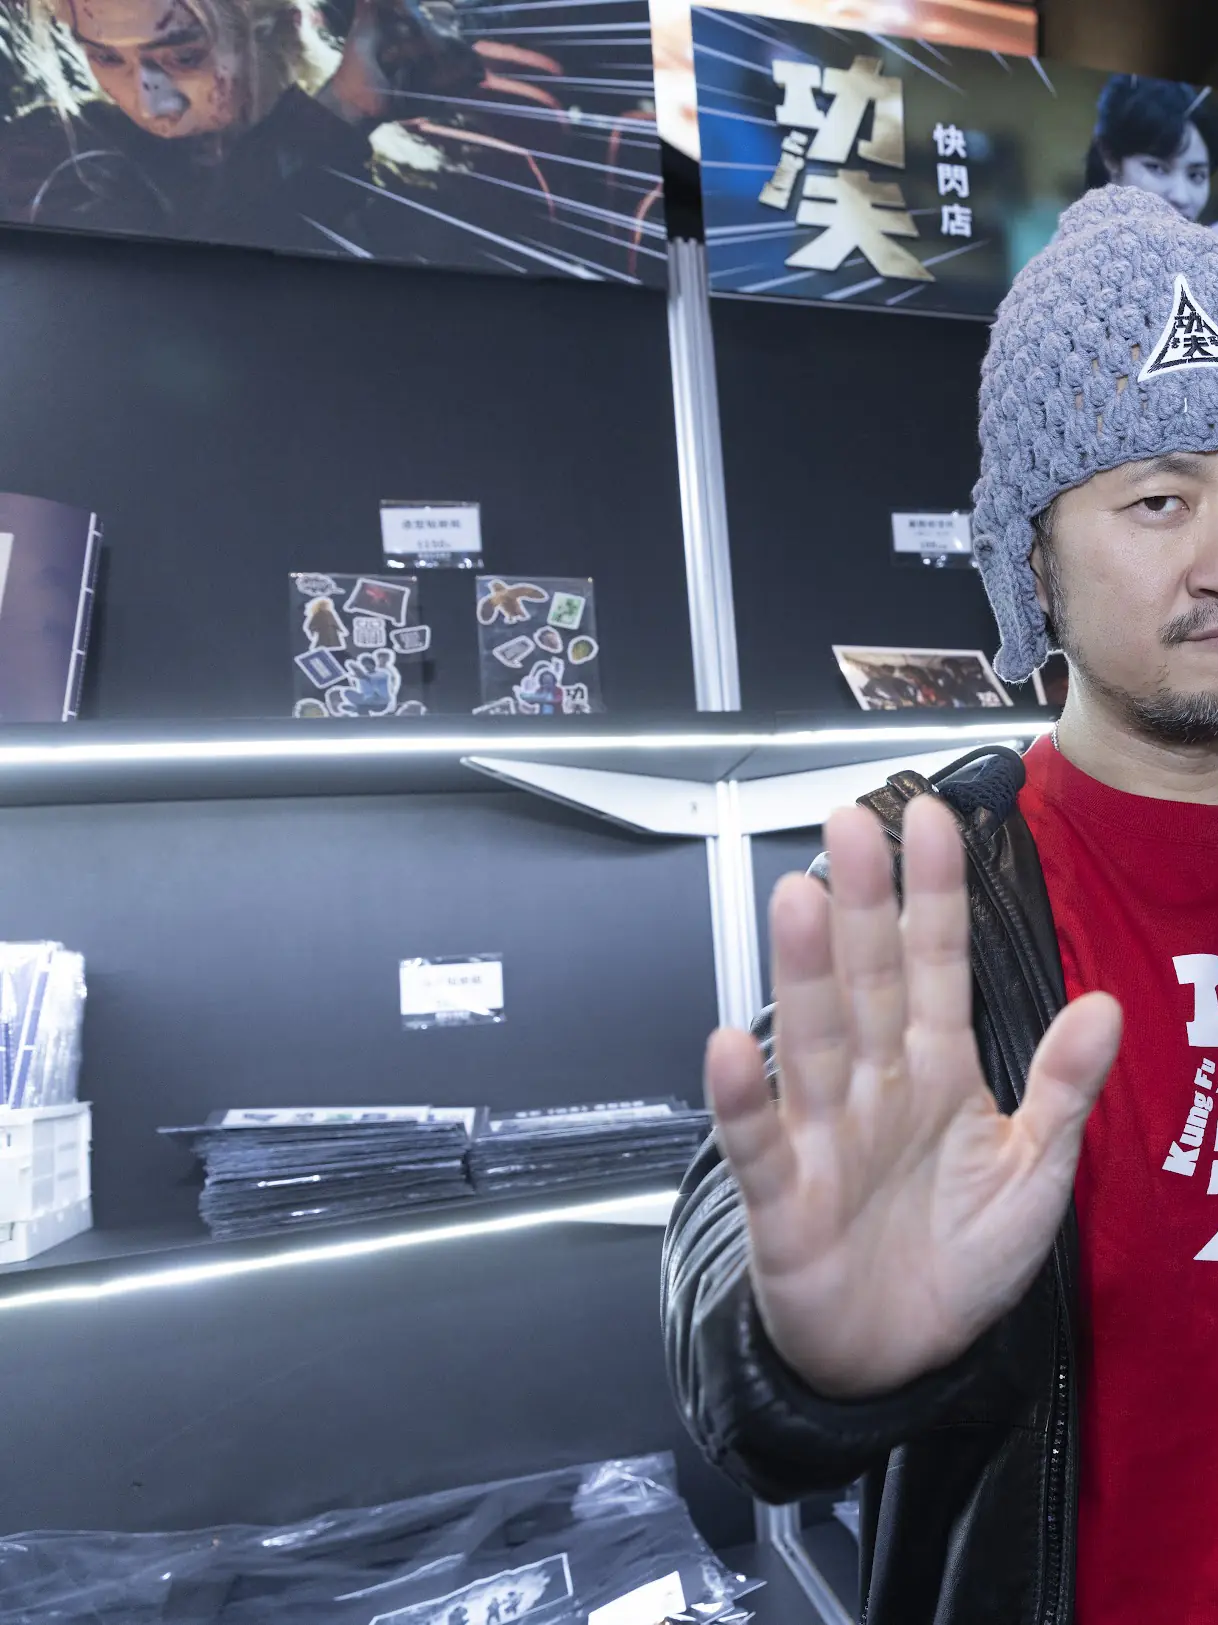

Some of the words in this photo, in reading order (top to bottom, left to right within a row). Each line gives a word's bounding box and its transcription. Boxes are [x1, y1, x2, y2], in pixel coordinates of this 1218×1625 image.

[771, 55, 936, 282] 功夫
[933, 123, 972, 237] 快閃店
[1174, 311, 1214, 358] 功夫
[1162, 1090, 1214, 1177] Kung
[1194, 1057, 1216, 1090] Fu
